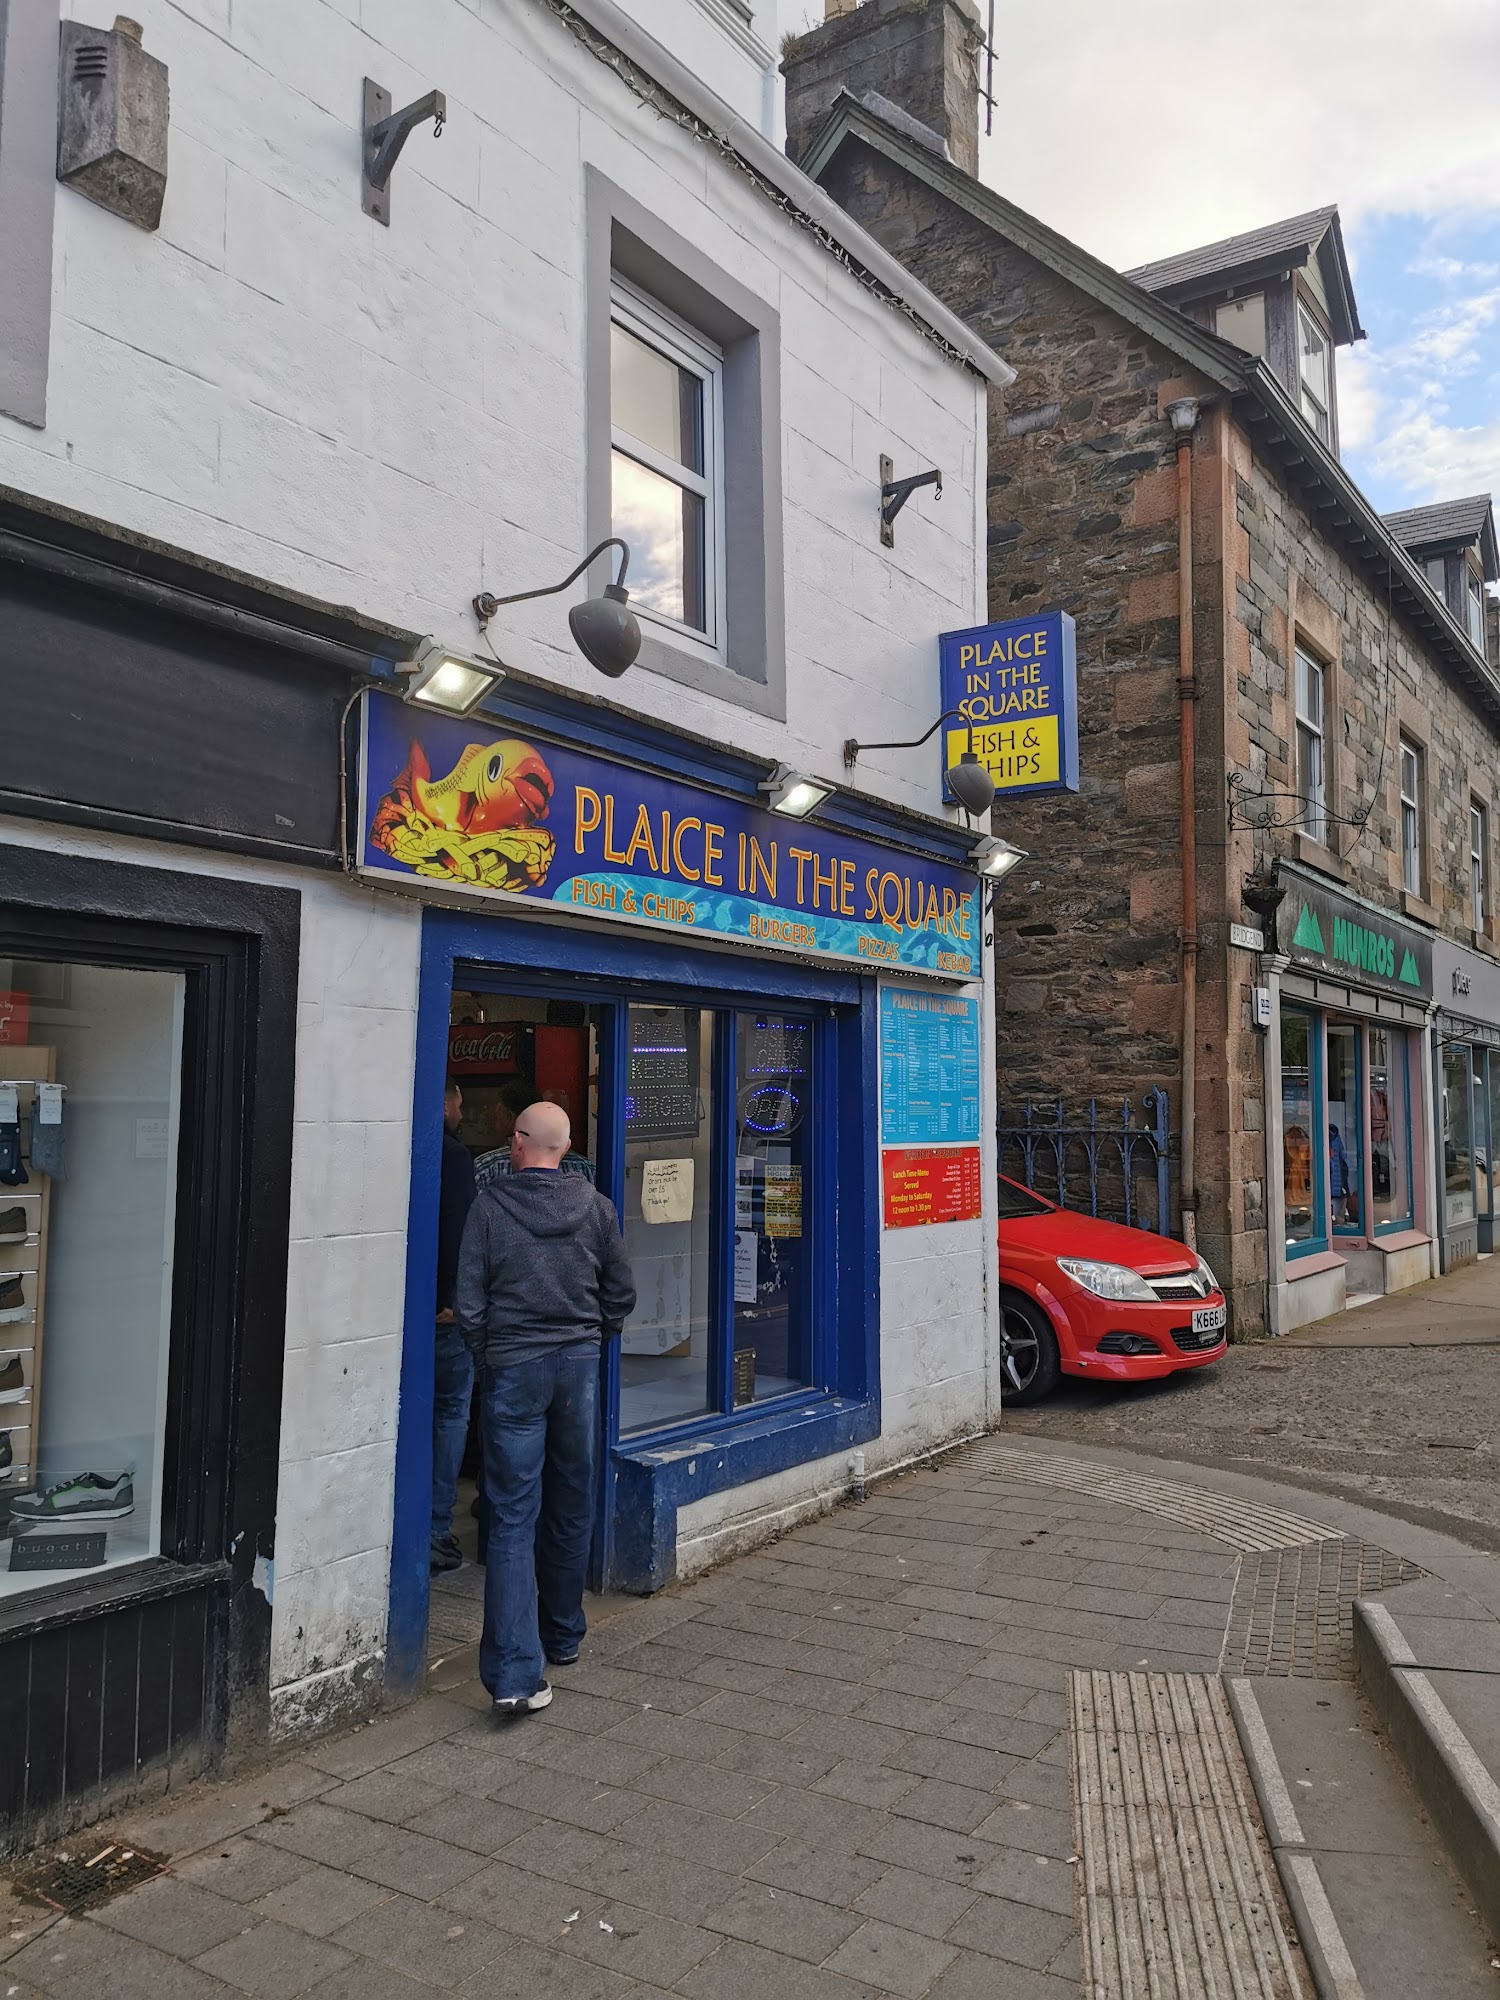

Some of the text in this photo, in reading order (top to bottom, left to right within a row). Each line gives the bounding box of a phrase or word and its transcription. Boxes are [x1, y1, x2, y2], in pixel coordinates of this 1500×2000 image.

[960, 630, 1047, 669] PLAICE
[966, 663, 1041, 694] IN THE
[958, 685, 1050, 721] SQUARE
[1023, 727, 1040, 748] &
[976, 753, 1041, 778] HIPS
[575, 785, 972, 940] PLAICE IN THE SQUARE
[571, 878, 696, 924] FISH & CHIPS
[749, 914, 817, 946] BURGERS
[1232, 926, 1262, 947] BRIDGEND
[858, 936, 899, 961] PIZZAS
[1333, 915, 1395, 979] MUNROS
[937, 951, 971, 974] KEBAB
[892, 992, 969, 1016] PLAICE IN THE SQUARE
[632, 1059, 688, 1078] KEBAB
[626, 1095, 692, 1119] BURGER
[745, 1098, 800, 1121] OPEN
[893, 1169, 929, 1179] Lunch Time Menu
[904, 1181, 919, 1189] Served
[891, 1194, 908, 1203] Monday
[914, 1192, 932, 1201] Saturday
[1196, 1310, 1219, 1329] K666
[18, 1541, 100, 1554] bugatti
